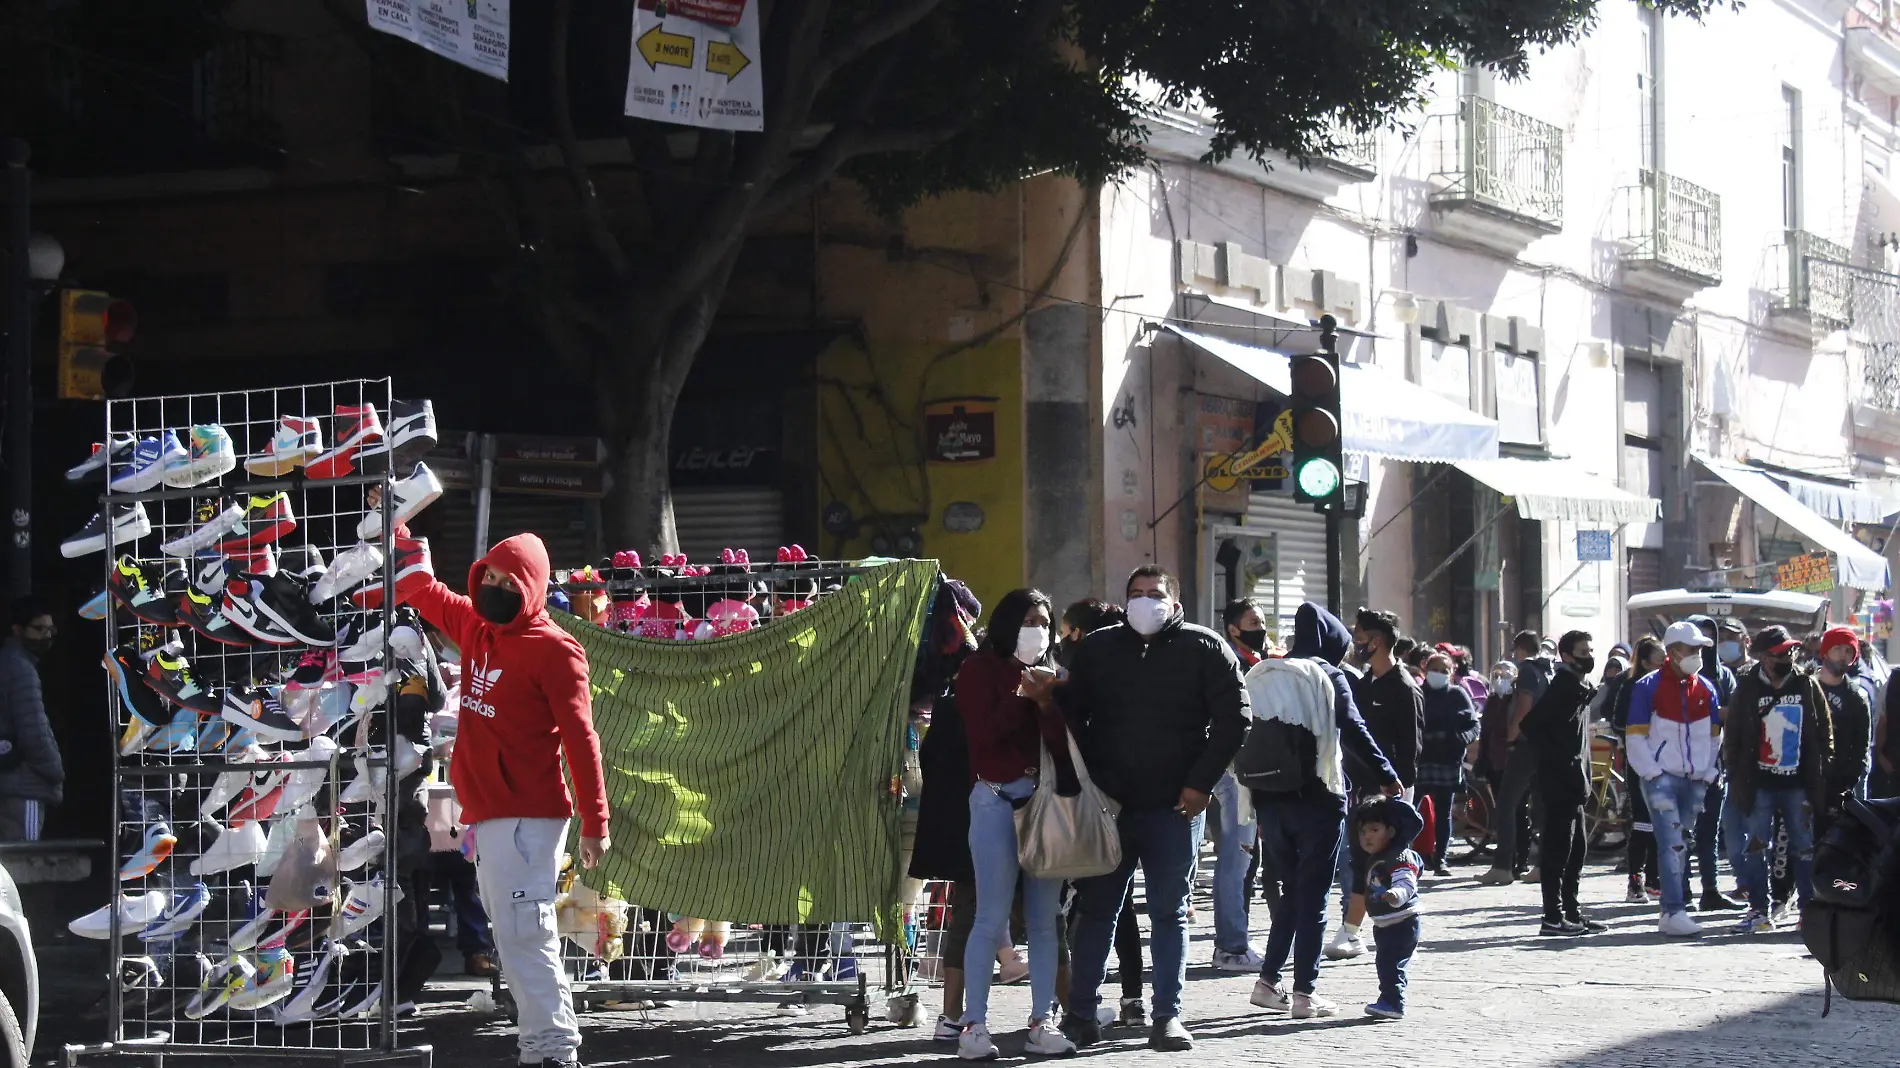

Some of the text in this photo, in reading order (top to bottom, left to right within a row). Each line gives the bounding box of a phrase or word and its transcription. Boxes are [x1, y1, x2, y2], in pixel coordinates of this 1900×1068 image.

[378, 7, 409, 23] EN CASA
[473, 32, 507, 50] SEMAFORO
[474, 42, 506, 58] NARANJA
[655, 43, 689, 58] 3 NORTE
[725, 108, 761, 117] DISTANCIA
[959, 432, 982, 446] Mayo
[461, 695, 496, 718] adas
[1779, 694, 1802, 705] HOP
